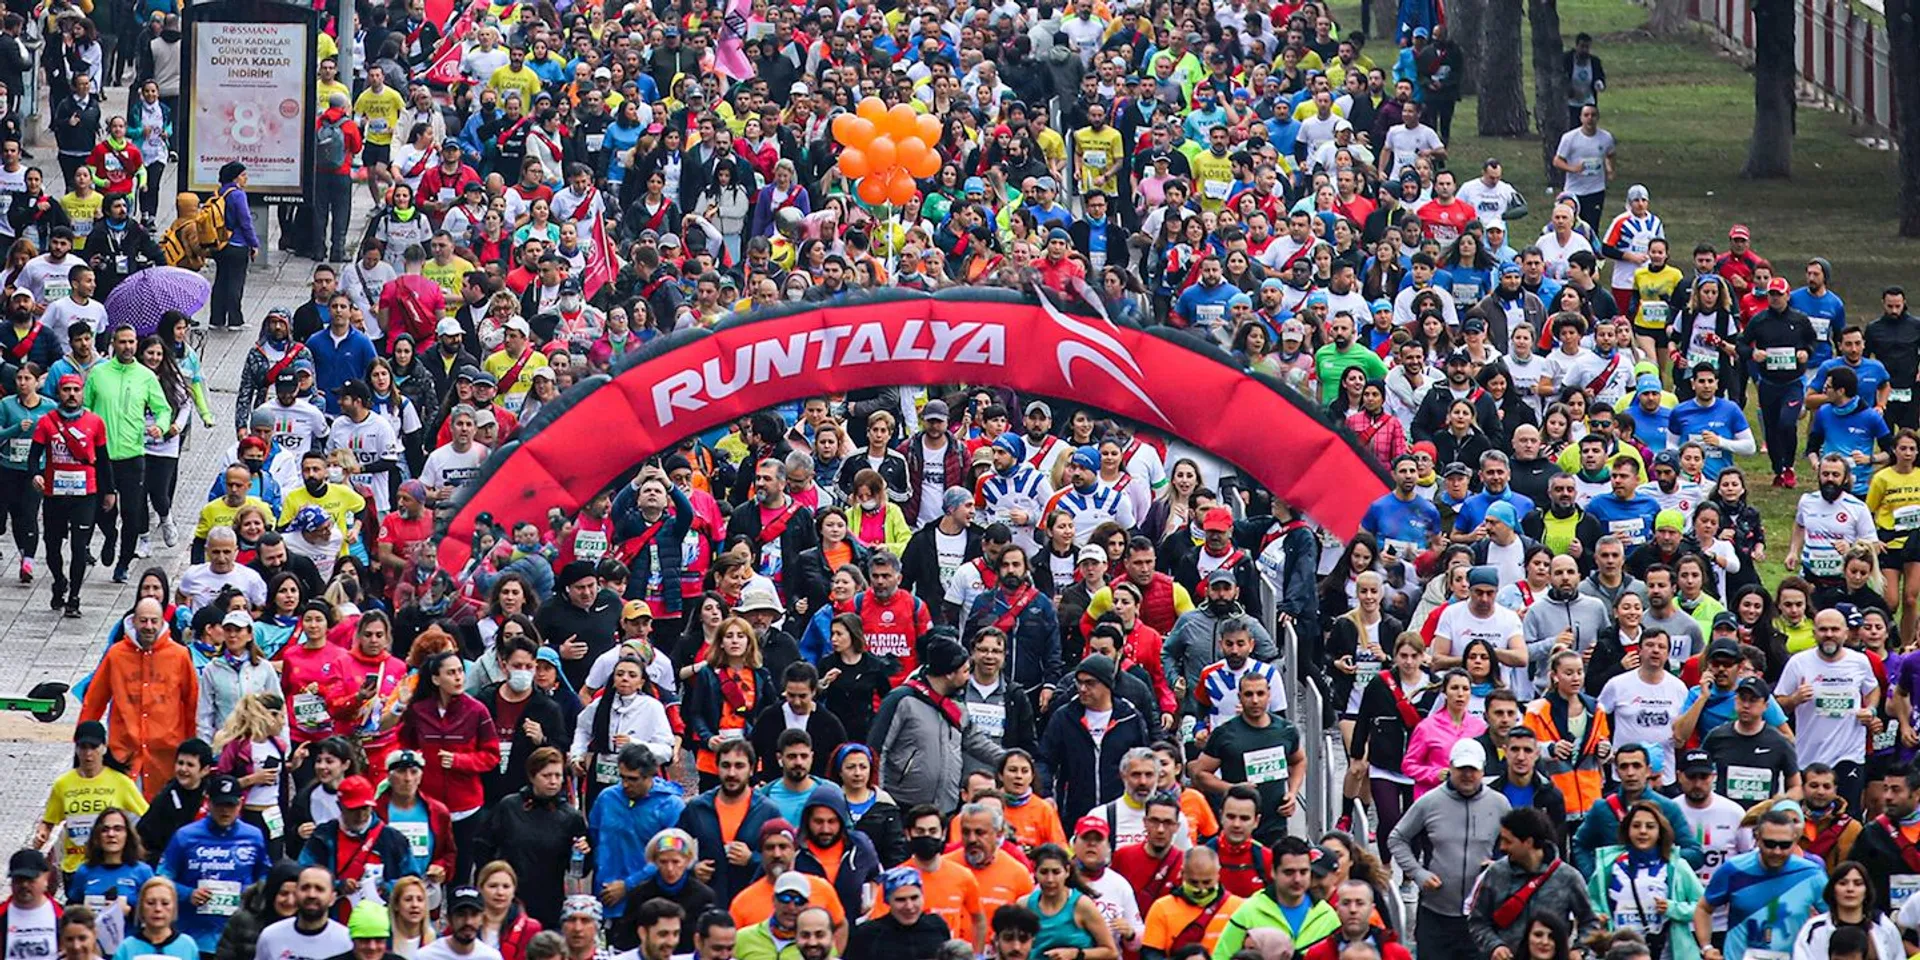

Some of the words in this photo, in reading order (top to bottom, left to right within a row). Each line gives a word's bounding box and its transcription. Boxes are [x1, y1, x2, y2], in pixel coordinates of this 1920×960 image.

[211, 36, 243, 46] DÜNYA
[260, 46, 284, 55] ÖZEL
[210, 55, 250, 66] DÜNYA
[252, 57, 291, 67] KADAR
[231, 101, 263, 145] 8
[651, 321, 1006, 428] RUNTALYA
[863, 633, 908, 647] YARIDA
[1822, 698, 1849, 708] 5505
[1734, 779, 1763, 791] 6648
[1703, 850, 1729, 868] GT
[210, 893, 234, 906] 572
